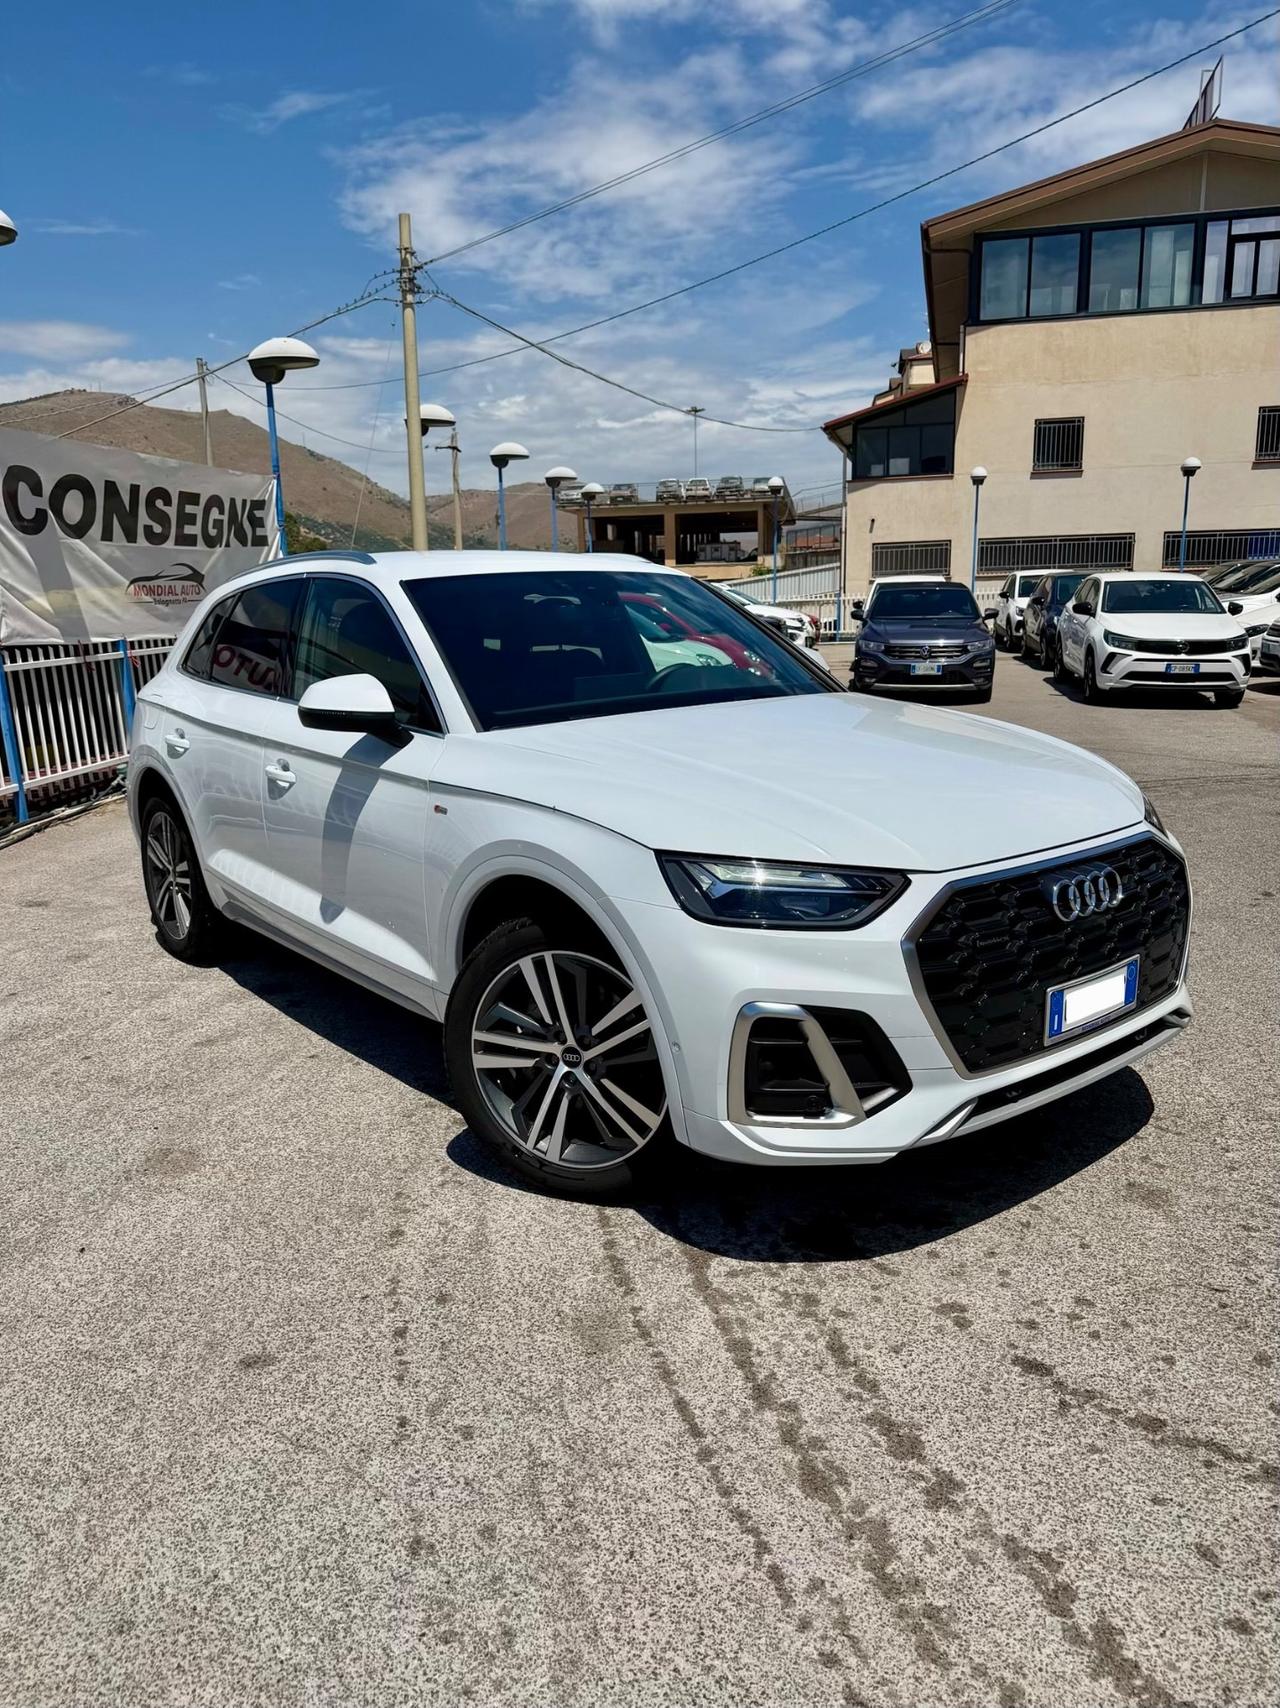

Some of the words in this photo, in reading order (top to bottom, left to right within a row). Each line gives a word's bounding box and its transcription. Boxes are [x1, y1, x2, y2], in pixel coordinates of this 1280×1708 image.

[2, 464, 269, 549] CONSEGNE
[133, 583, 179, 597] MONDIAL
[180, 583, 201, 597] AUTO
